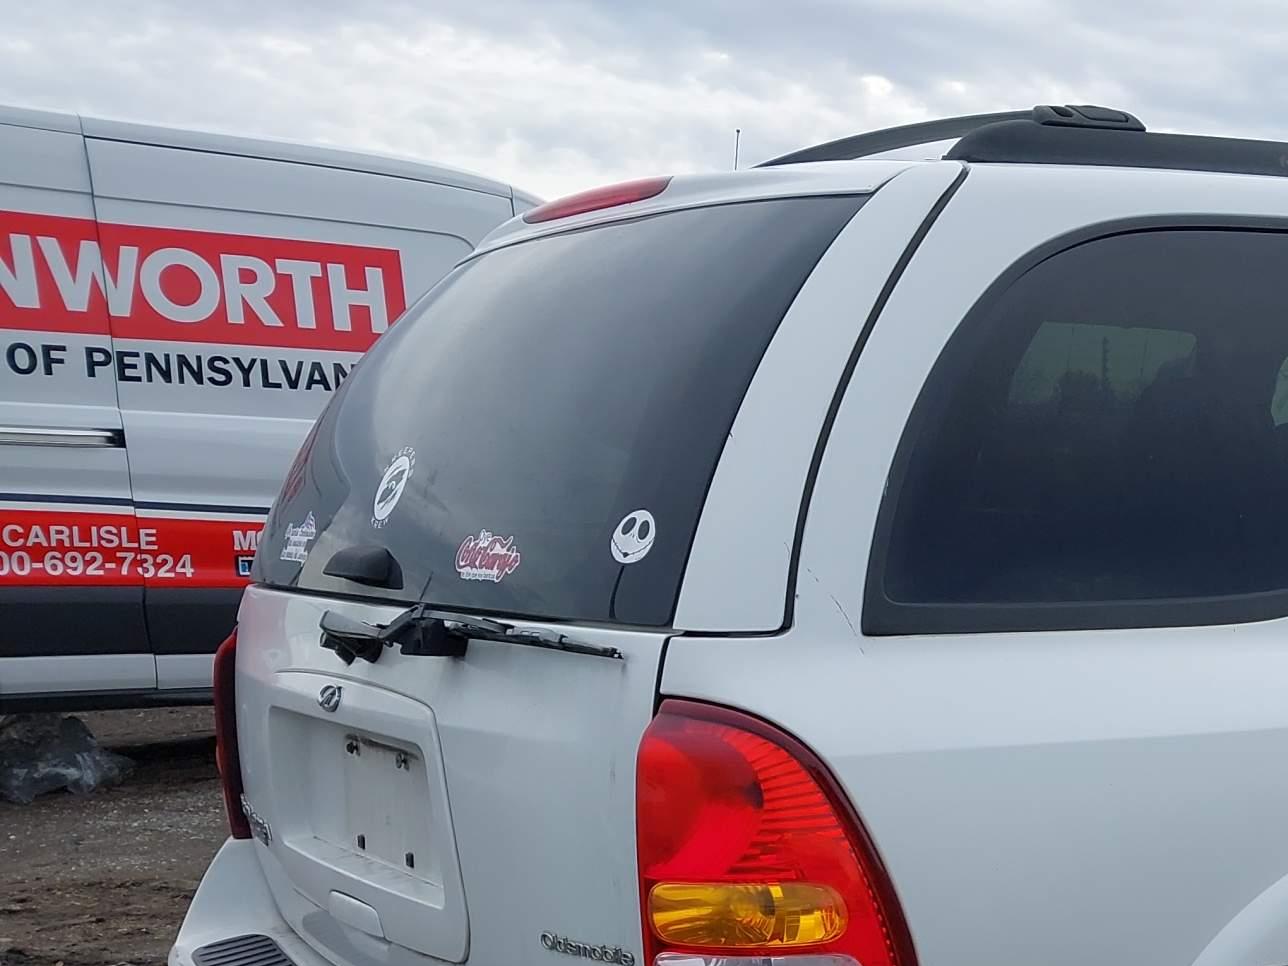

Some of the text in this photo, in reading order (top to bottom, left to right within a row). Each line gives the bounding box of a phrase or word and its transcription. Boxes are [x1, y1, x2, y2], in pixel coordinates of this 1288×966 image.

[6, 342, 67, 376] OF
[2, 524, 158, 550] CARLISLE
[540, 931, 635, 966] Oldsmobile
